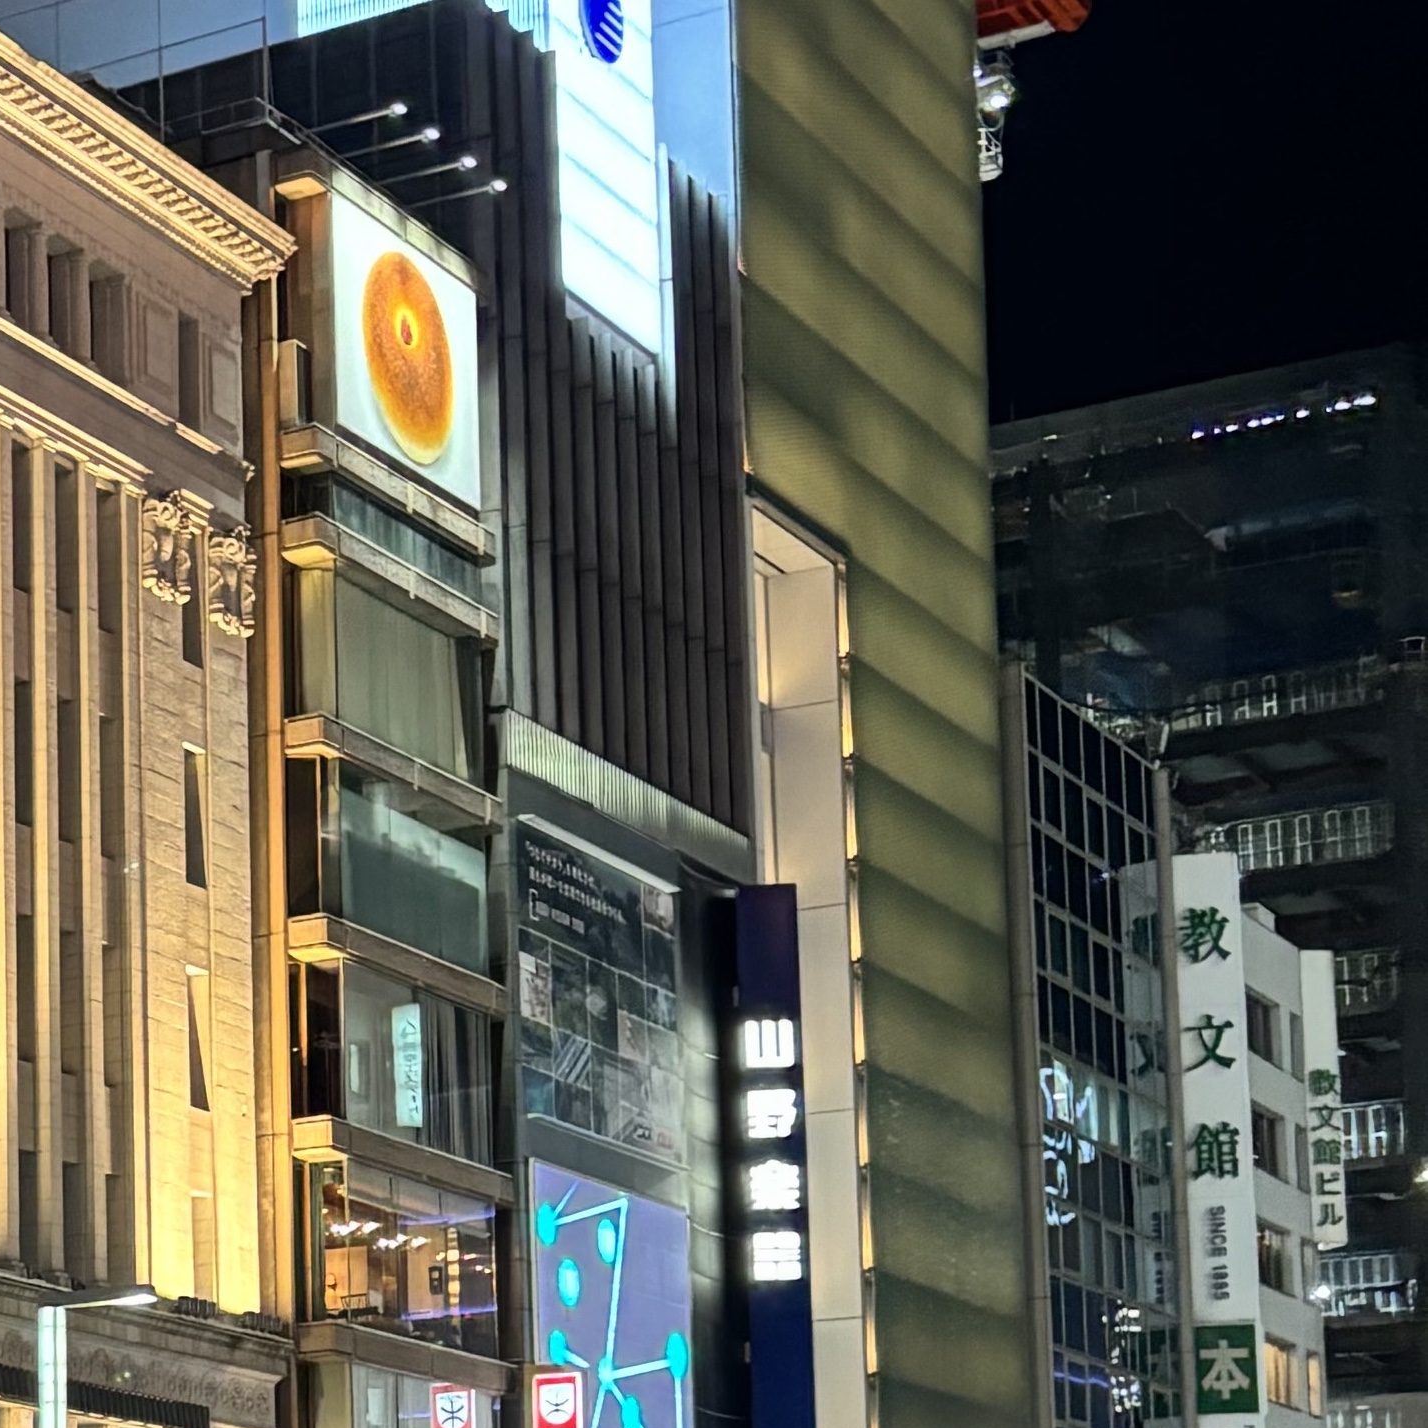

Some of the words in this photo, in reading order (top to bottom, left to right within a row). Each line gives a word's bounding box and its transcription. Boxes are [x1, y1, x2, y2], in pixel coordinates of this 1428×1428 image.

[1179, 906, 1239, 1181] 教文館
[1308, 1068, 1344, 1227] 教文館ビル
[1206, 1205, 1228, 1258] SINCE
[1199, 1339, 1250, 1400] 本
